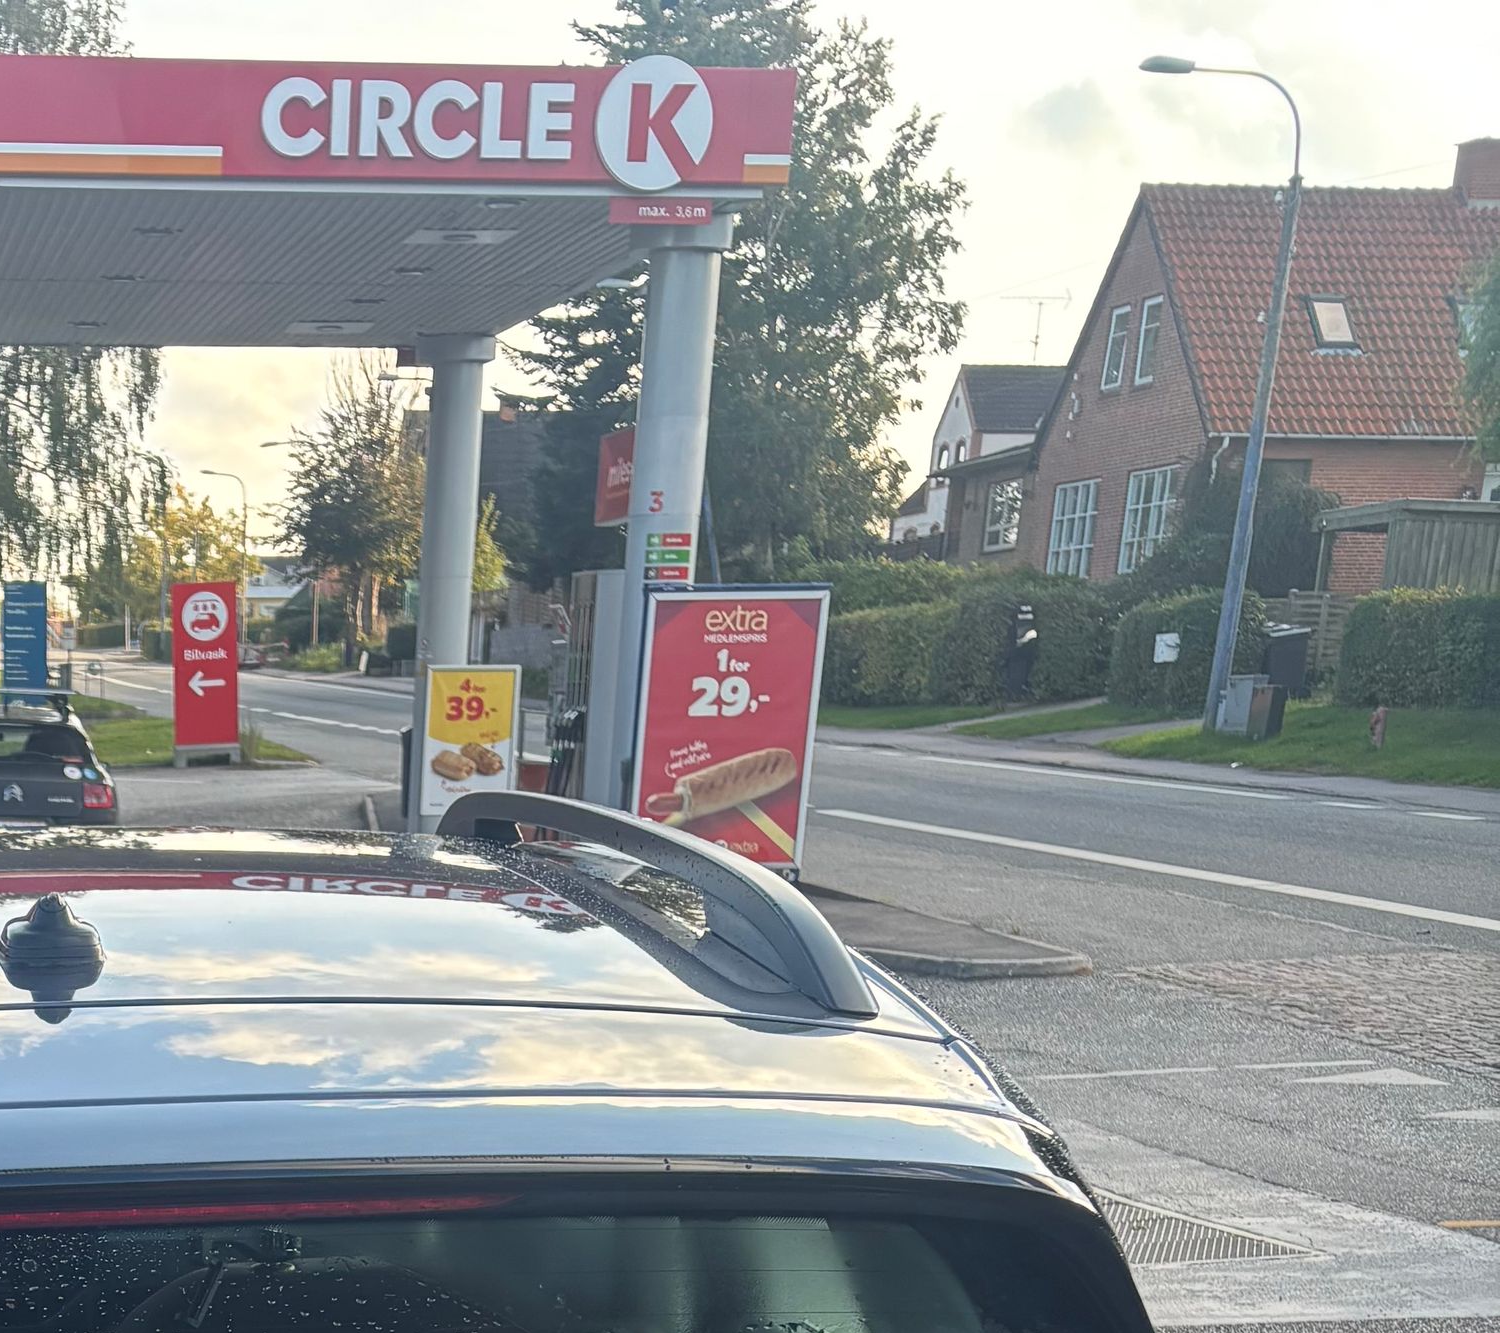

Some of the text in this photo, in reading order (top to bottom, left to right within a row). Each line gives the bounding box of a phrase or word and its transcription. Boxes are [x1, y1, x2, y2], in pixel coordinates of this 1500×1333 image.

[261, 76, 699, 183] CIRCLE K
[638, 205, 670, 217] max.
[648, 490, 665, 513] 3
[705, 604, 769, 632] extra
[716, 648, 751, 673] 1 for
[459, 678, 472, 694] 4
[687, 675, 771, 718] 29,-
